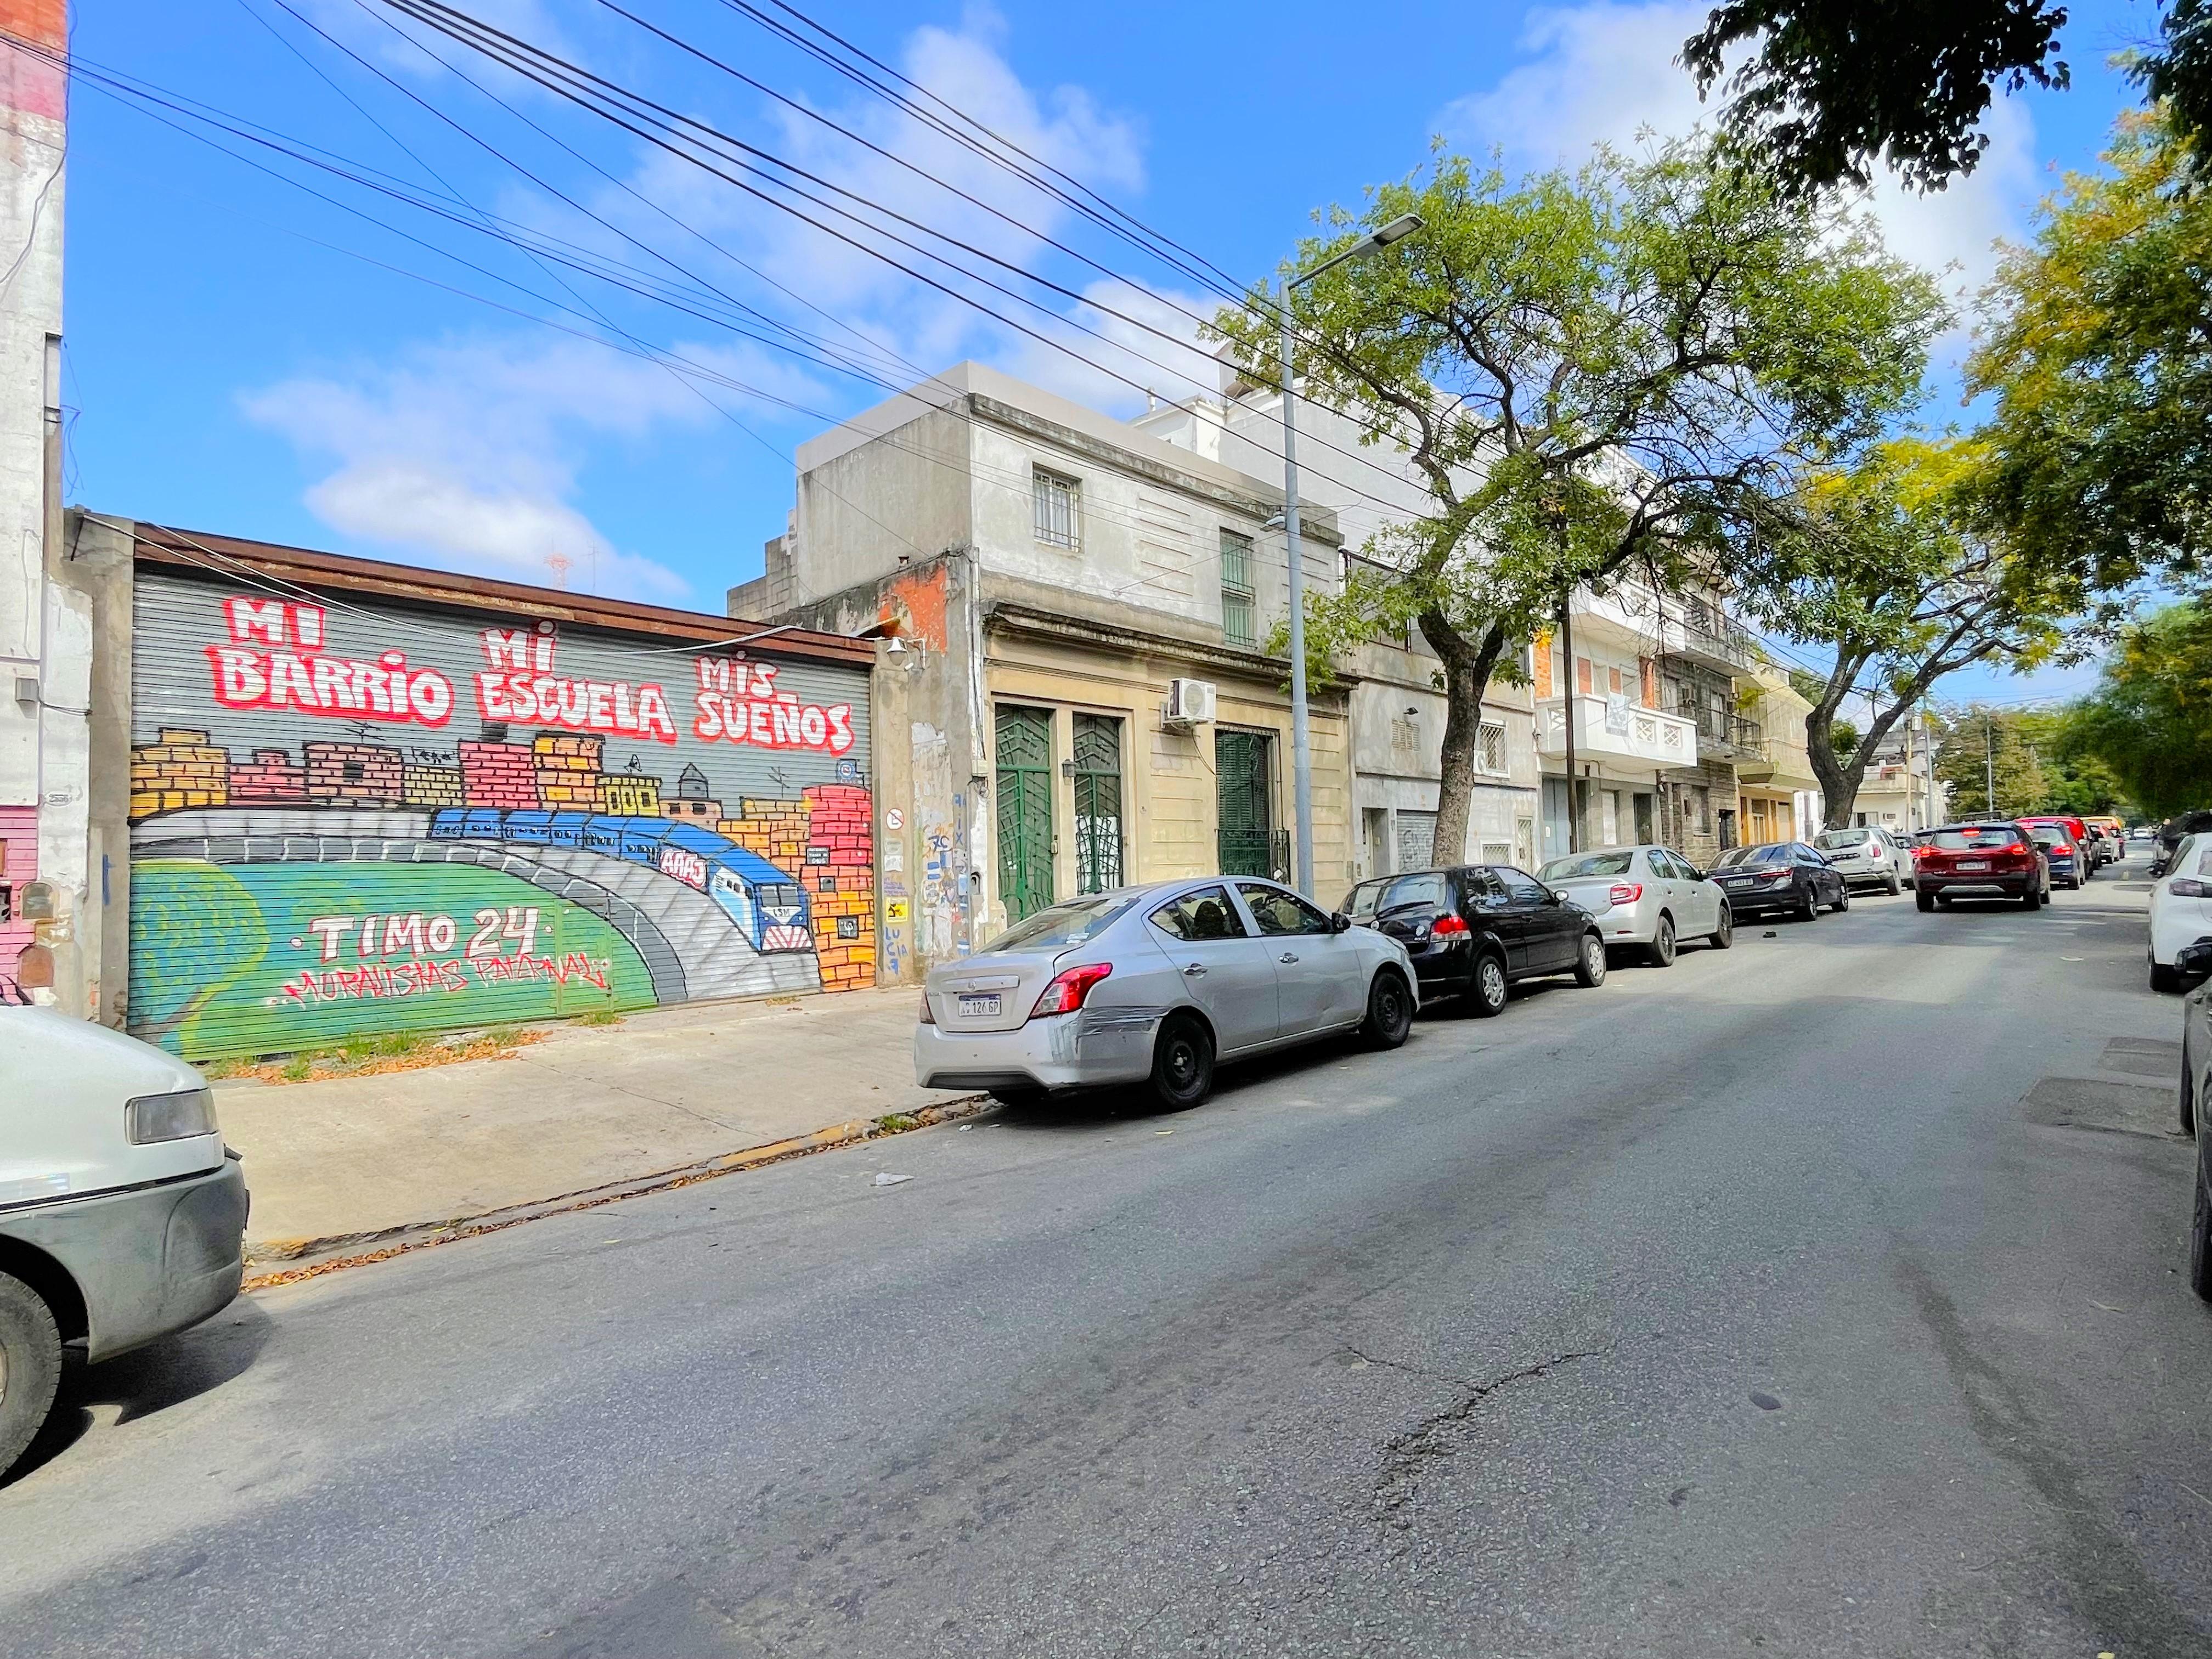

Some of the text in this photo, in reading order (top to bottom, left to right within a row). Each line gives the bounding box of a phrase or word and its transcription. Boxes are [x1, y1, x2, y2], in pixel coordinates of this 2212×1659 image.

[223, 595, 326, 652] MI
[473, 672, 678, 746] ESCUELA
[693, 691, 855, 757] SUEÑOS
[308, 906, 540, 963] TIMO 24
[989, 1001, 998, 1013] GP
